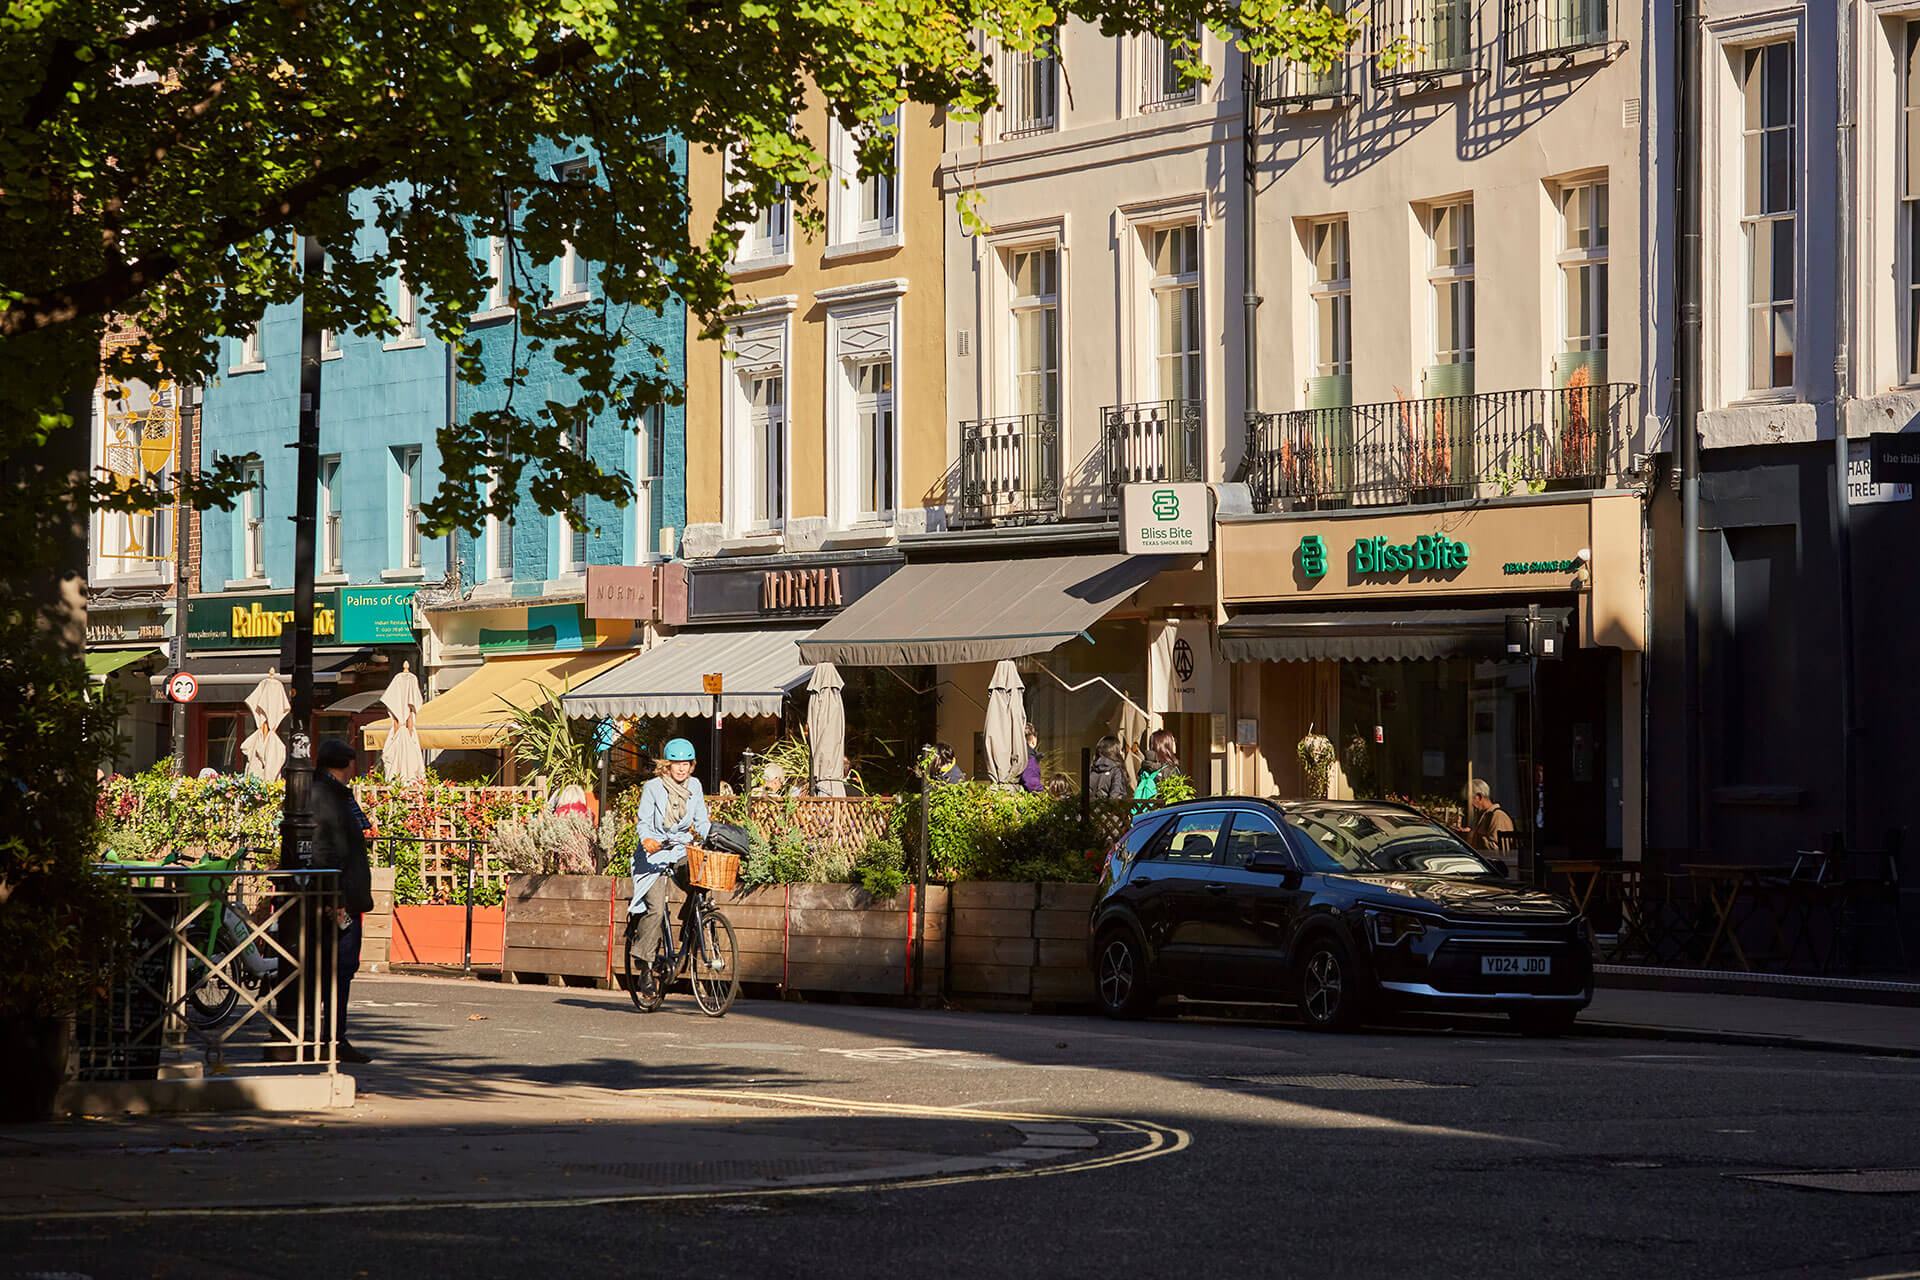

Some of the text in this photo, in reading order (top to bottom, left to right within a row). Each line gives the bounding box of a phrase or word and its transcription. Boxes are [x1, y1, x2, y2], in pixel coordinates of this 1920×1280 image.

[1882, 453, 1899, 464] the
[1848, 481, 1880, 498] TREET
[1141, 527, 1193, 539] Bliss Bite
[1355, 531, 1470, 573] Bliss Bite
[1503, 562, 1530, 574] TEXAS
[1530, 561, 1559, 573] SMOKE
[596, 585, 646, 601] NORMA
[763, 568, 842, 609] NORMA
[346, 595, 379, 607] Palms
[380, 594, 393, 606] of
[231, 602, 283, 638] Palms
[1487, 958, 1546, 973] YD24 JDO
